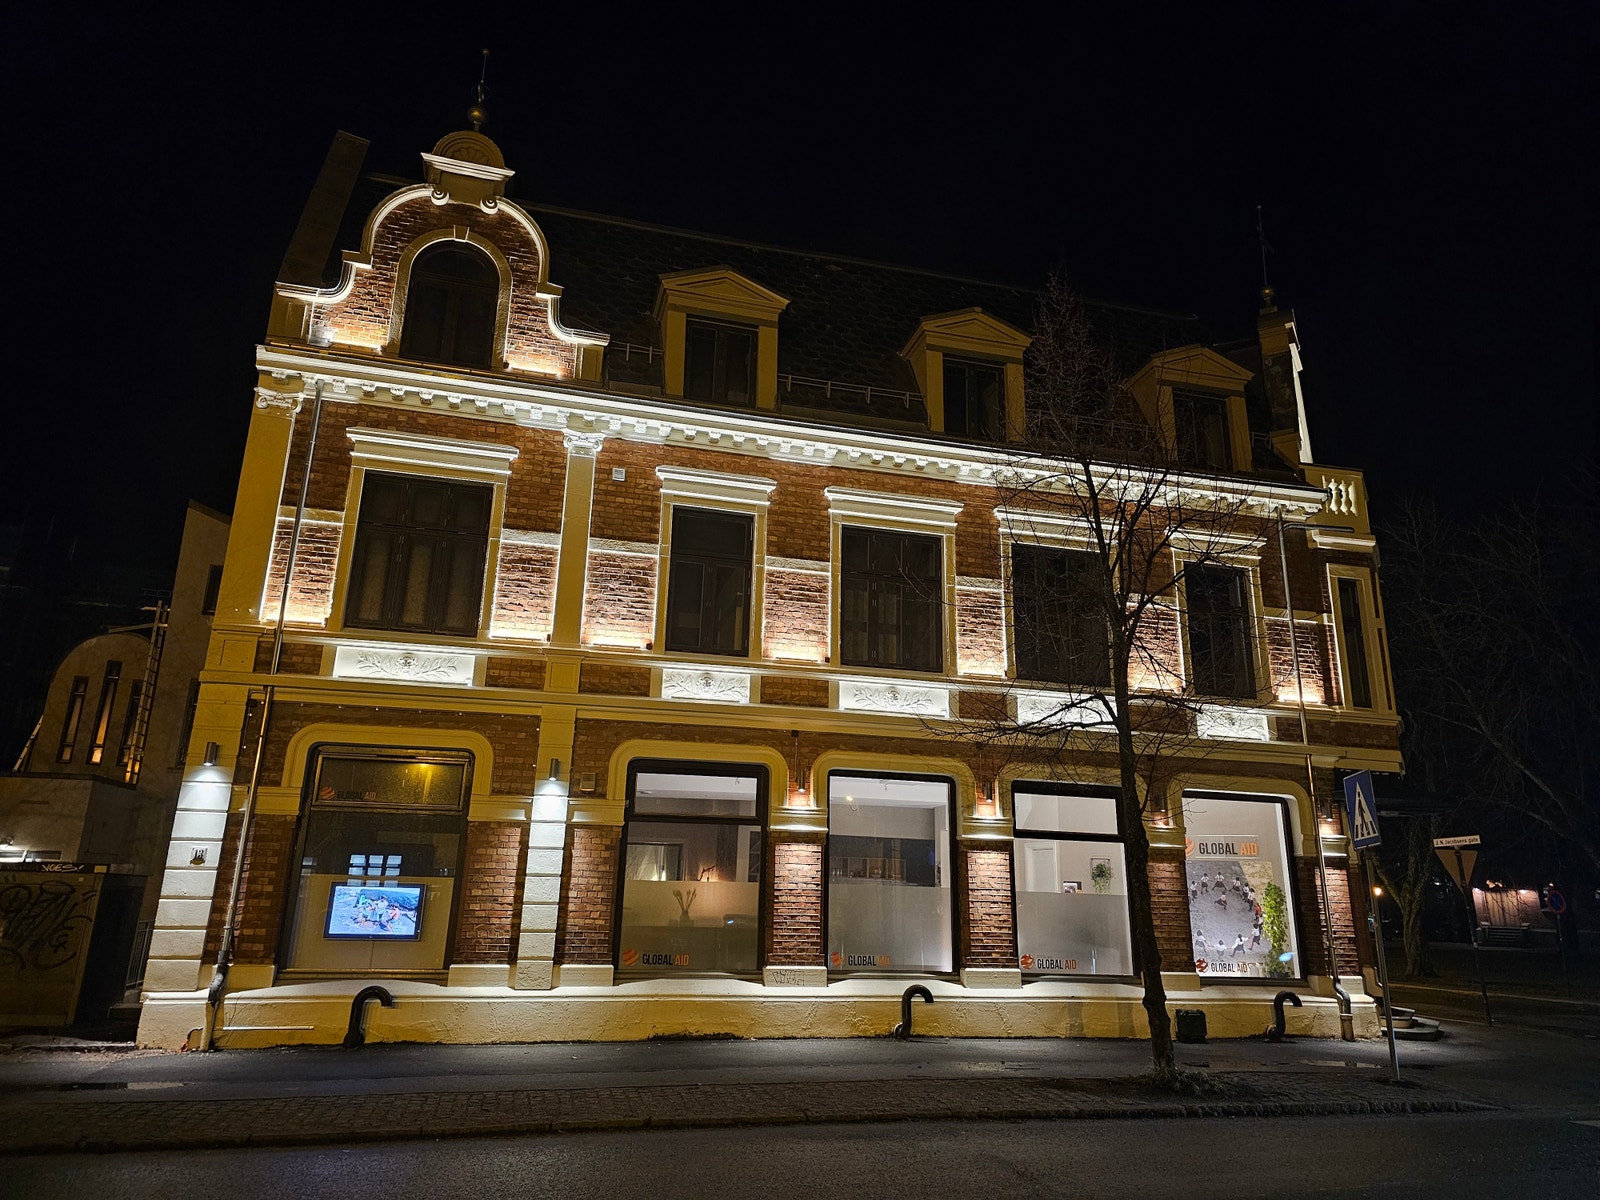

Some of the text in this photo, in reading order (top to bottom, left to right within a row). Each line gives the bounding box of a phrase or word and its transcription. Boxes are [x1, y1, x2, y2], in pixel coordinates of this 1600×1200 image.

[337, 790, 376, 800] GLOBAL AID
[1198, 842, 1258, 856] GLOBAL AID
[642, 953, 689, 966] GLOBAL AID
[848, 955, 891, 966] GLOBAL AID
[1037, 958, 1077, 969] GLOBAL AID
[1210, 962, 1248, 973] GLOBAL AID
